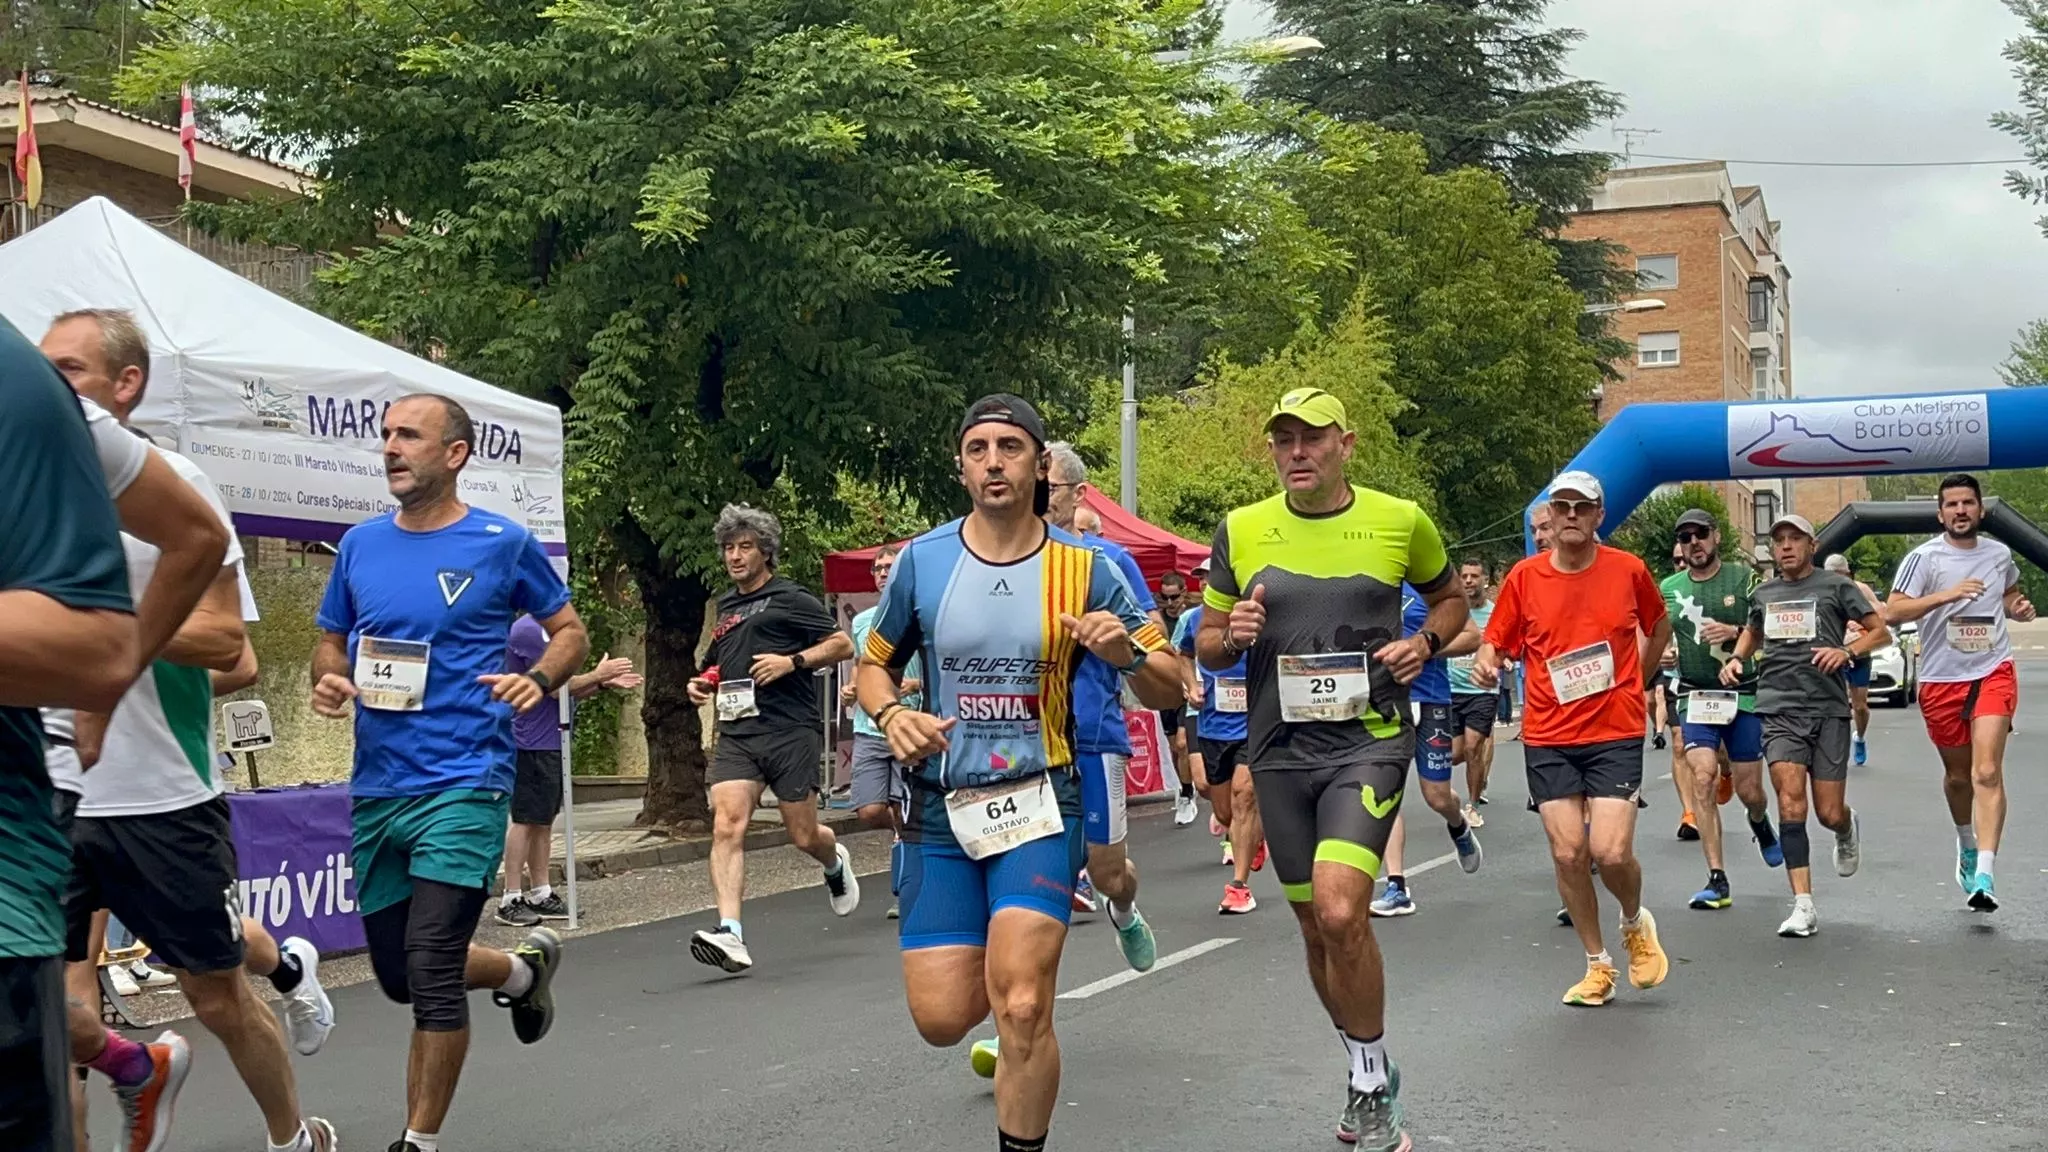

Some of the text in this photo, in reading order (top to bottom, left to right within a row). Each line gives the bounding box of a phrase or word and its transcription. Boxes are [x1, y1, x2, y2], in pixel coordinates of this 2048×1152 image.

[1854, 400, 1980, 417] Club Atletismo
[1855, 416, 1981, 439] Barbastro
[191, 442, 236, 459] DIUMENGE
[273, 453, 292, 466] 2024
[338, 460, 368, 475] Vithas
[273, 490, 292, 503] 2024
[297, 491, 330, 507] Curses
[1776, 613, 1804, 623] 1030
[1959, 627, 1987, 637] 1020
[372, 662, 392, 680] 44
[1564, 660, 1602, 680] 1035
[1310, 678, 1337, 694] 29
[726, 694, 739, 704] 33
[1311, 697, 1339, 705] JAIME
[1706, 702, 1720, 710] 58
[985, 796, 1018, 820] 64
[982, 816, 1030, 836] GUSTAVO
